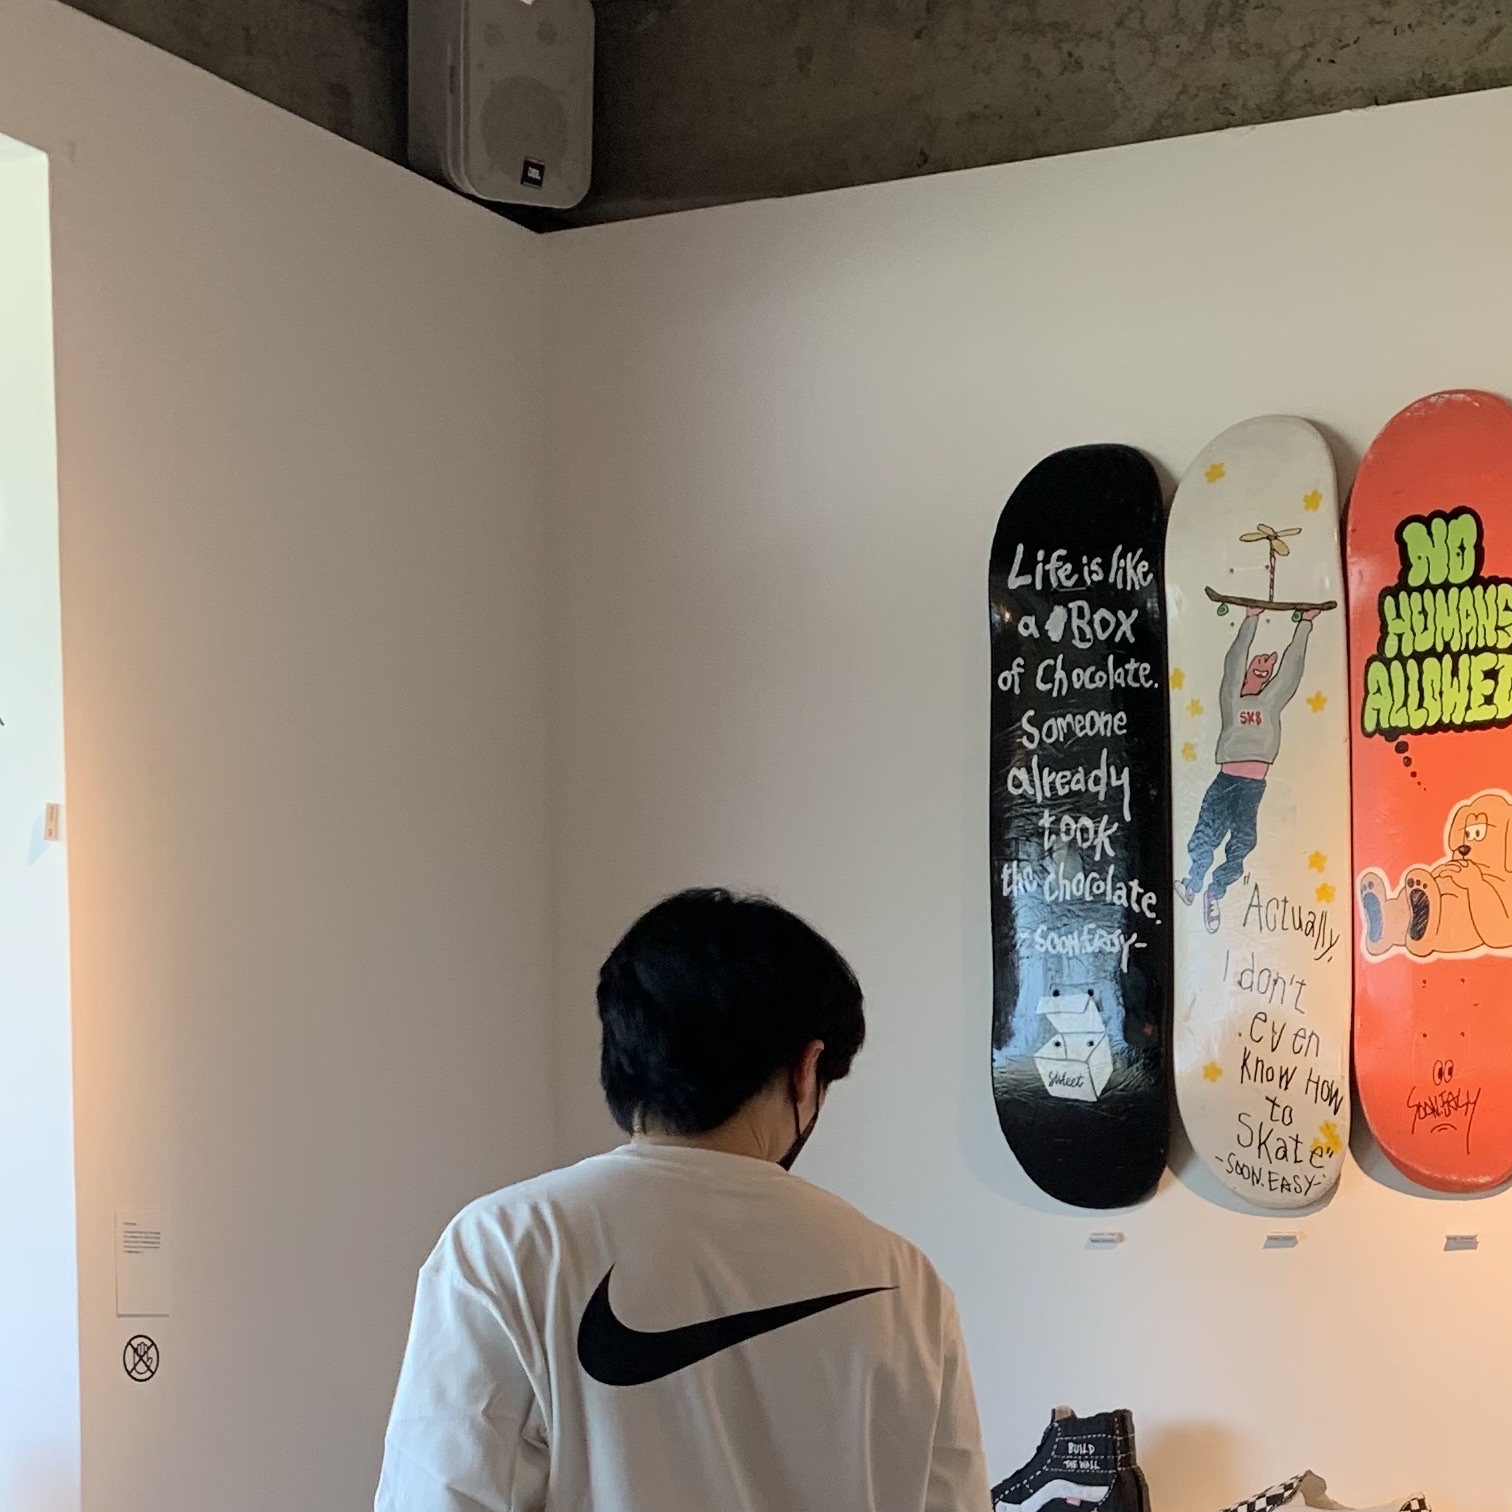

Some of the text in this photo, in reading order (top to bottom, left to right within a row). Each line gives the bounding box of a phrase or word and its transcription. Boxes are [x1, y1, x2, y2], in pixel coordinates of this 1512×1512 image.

[1007, 543, 1154, 591] Life is like
[1402, 513, 1477, 586] NO
[1018, 615, 1039, 639] a
[998, 657, 1025, 694] of
[1021, 709, 1127, 750] Someone
[1237, 952, 1306, 1014] don't
[1250, 1011, 1319, 1058] even
[1265, 1096, 1293, 1126] to
[1063, 1460, 1100, 1469] THE WALL
[1068, 1442, 1095, 1454] BUILD
